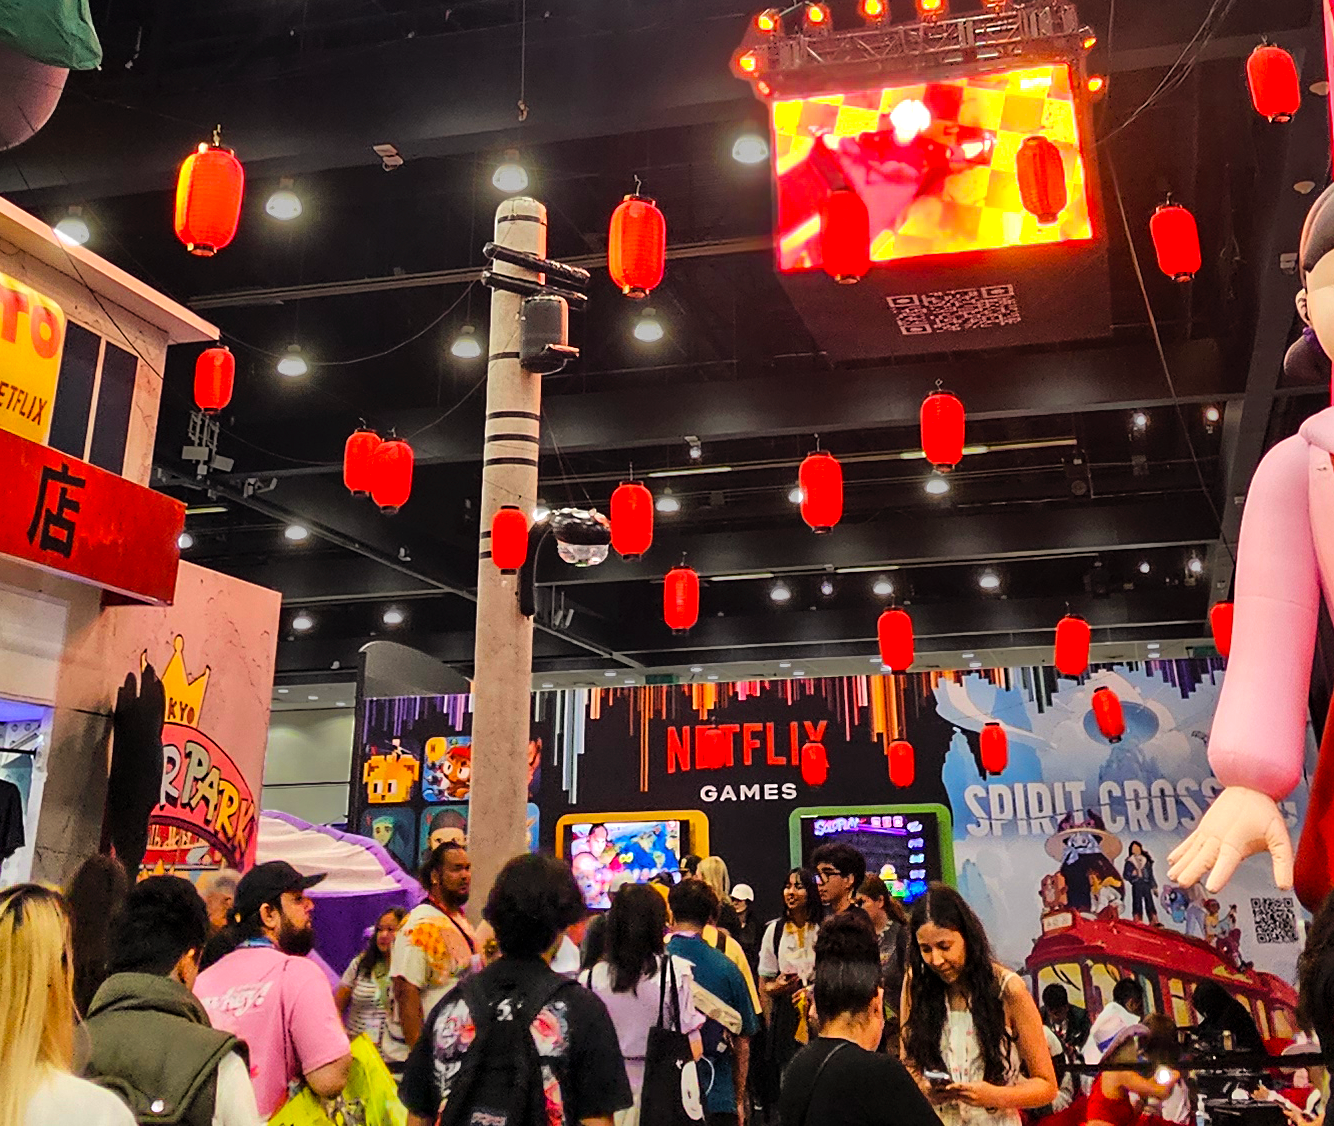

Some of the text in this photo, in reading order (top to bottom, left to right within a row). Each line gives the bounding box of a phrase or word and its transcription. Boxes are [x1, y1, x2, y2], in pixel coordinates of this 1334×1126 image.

[167, 697, 195, 725] KYO
[181, 739, 255, 854] PARK
[700, 782, 797, 803] GAMES
[964, 780, 1086, 837] SPIRIT
